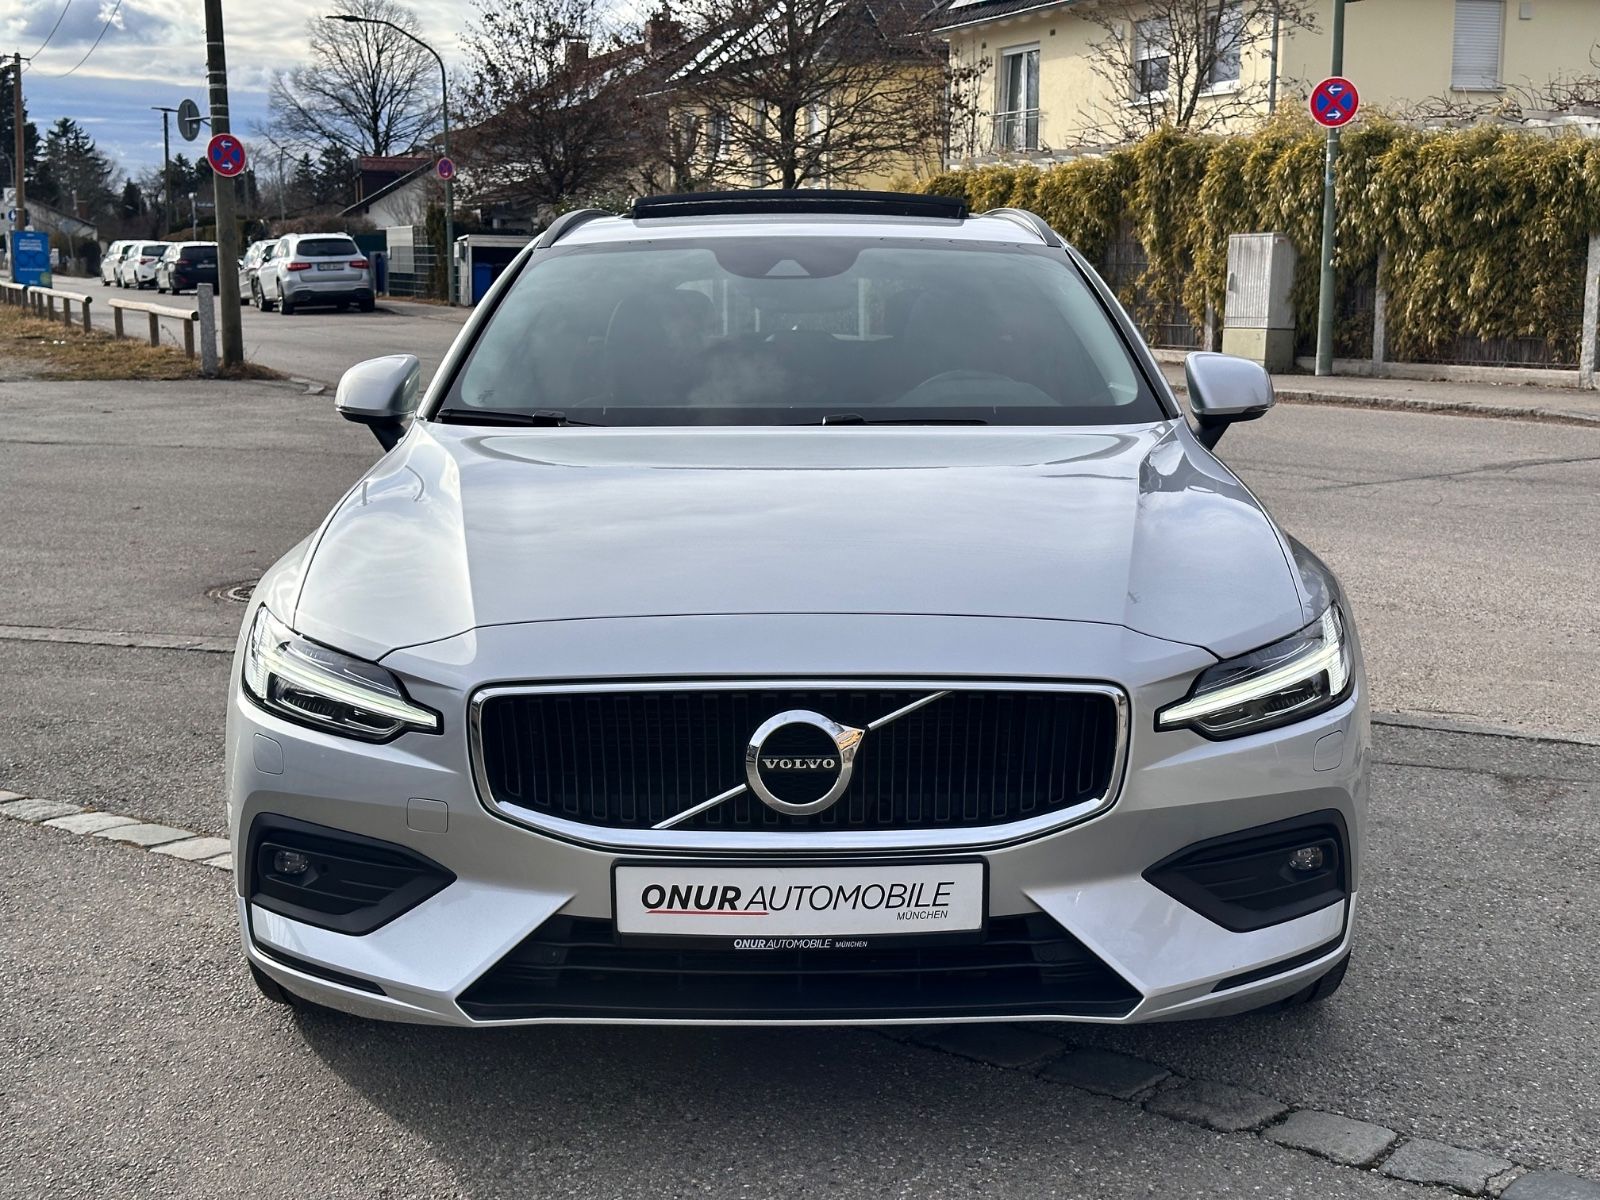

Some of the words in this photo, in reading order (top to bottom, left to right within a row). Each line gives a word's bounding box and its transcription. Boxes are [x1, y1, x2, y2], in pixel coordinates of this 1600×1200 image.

[762, 758, 835, 769] VOLVO
[641, 884, 742, 910] ONUR
[744, 881, 955, 911] AUTOMOBILE
[896, 910, 949, 921] MÜNCHEN
[835, 940, 868, 948] MÜNCHEN
